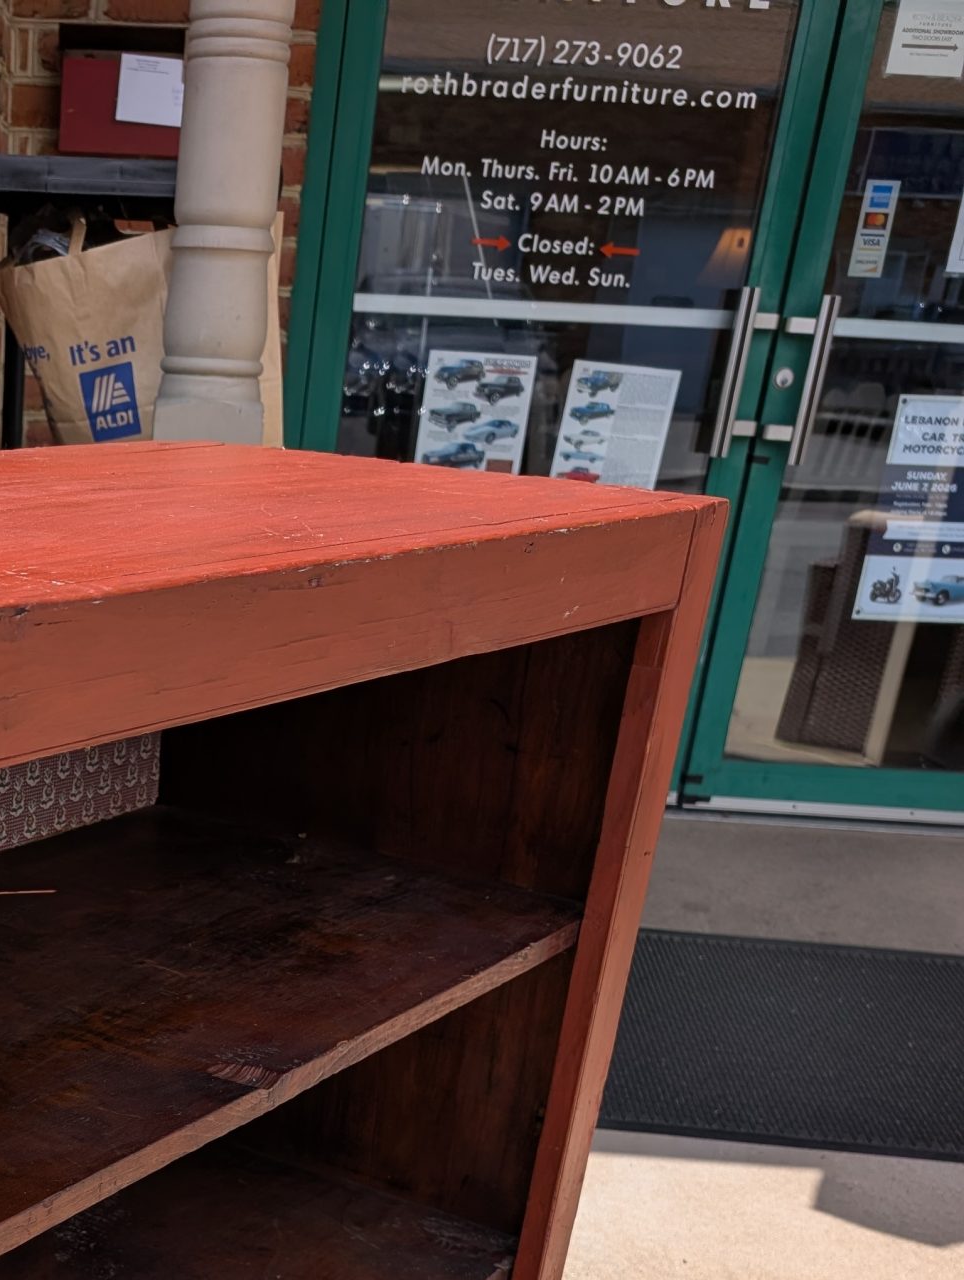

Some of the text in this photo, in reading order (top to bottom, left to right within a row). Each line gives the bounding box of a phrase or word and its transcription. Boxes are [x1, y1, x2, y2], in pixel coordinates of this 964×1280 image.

[486, 32, 683, 70] (717) 273-9062
[401, 71, 758, 110] rothbraderfurniture.com
[540, 129, 608, 152] Hours:
[421, 155, 472, 177] Mon.
[481, 158, 540, 181] Thurs.
[548, 161, 578, 183] Fri.
[480, 190, 520, 211] Sat.
[517, 233, 595, 256] Closed:
[862, 238, 881, 247] VISA
[472, 262, 631, 289] Tues. Wed. Sun.
[69, 340, 101, 366] It's
[105, 335, 136, 358] an
[96, 409, 134, 431] ALDI
[904, 415, 959, 426] LEBANON
[902, 445, 964, 456] MOTORCYC
[891, 481, 920, 491] JUNE
